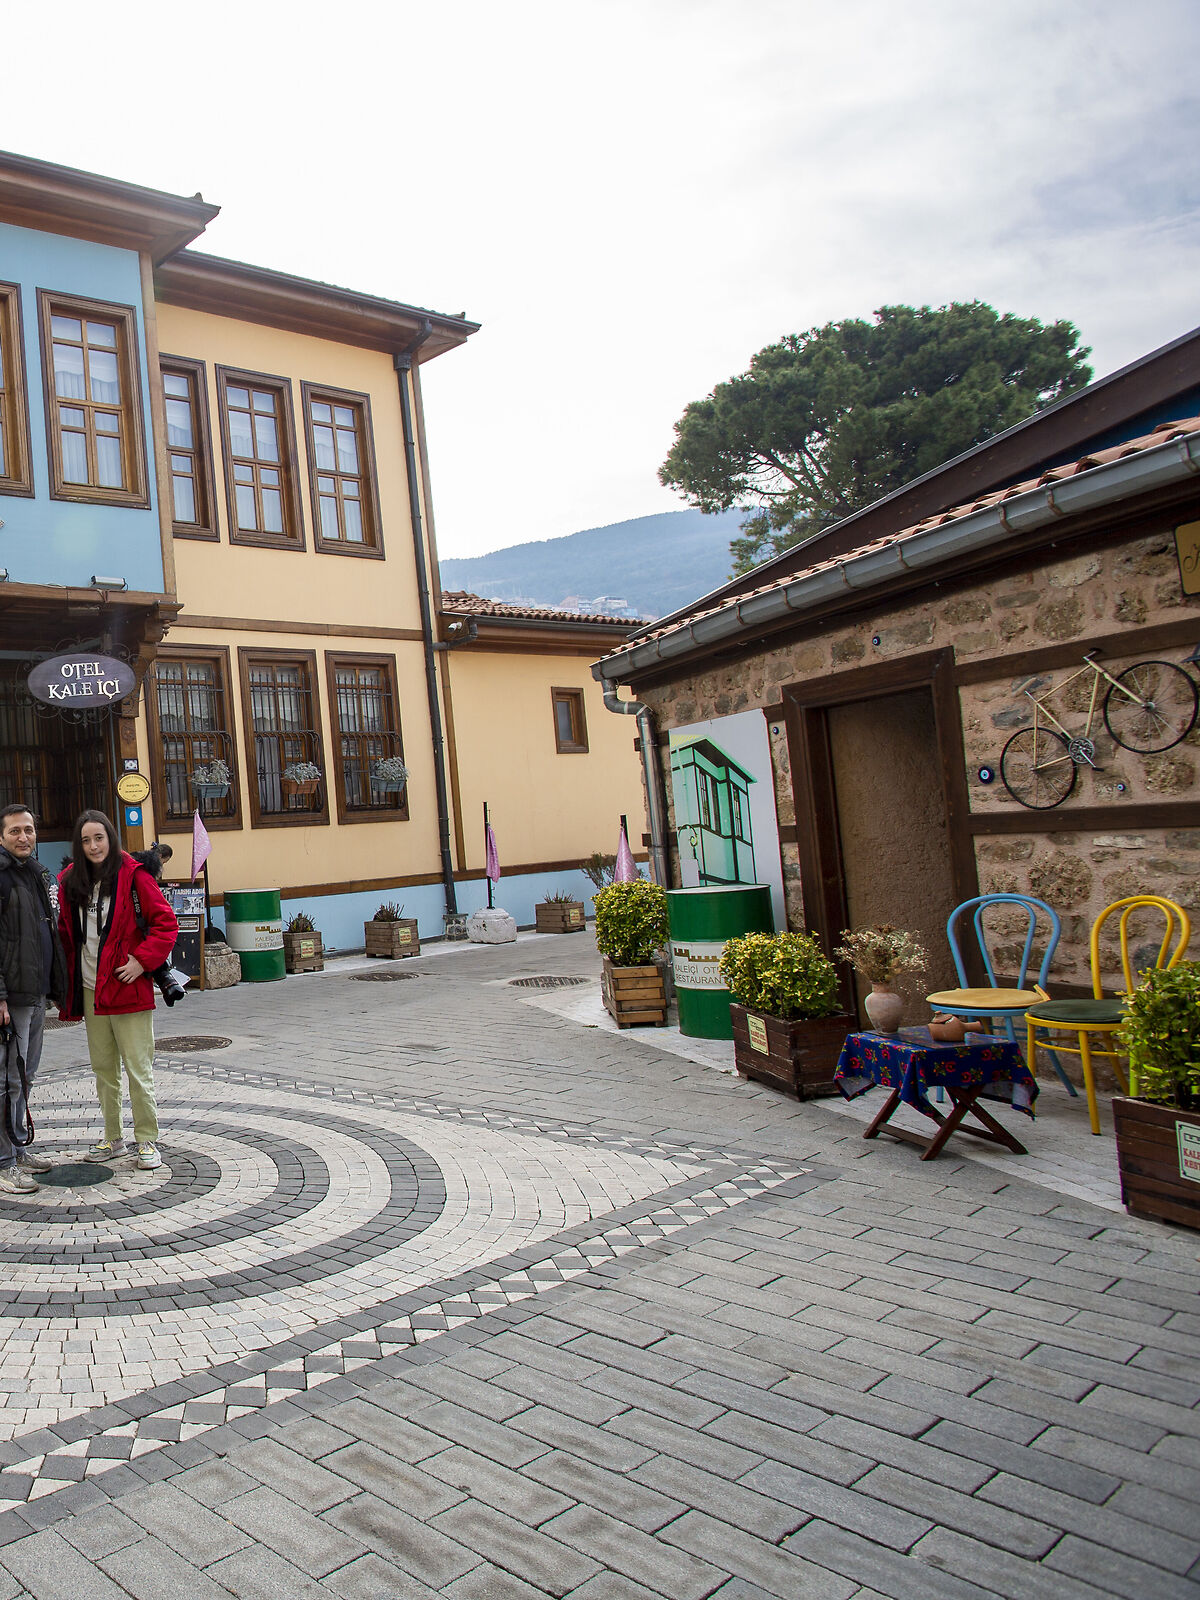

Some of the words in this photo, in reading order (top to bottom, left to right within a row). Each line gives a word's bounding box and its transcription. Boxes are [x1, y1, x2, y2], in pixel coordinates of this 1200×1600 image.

[61, 662, 105, 680] OTEL
[48, 682, 93, 700] KALE
[97, 677, 121, 700] İÇİ
